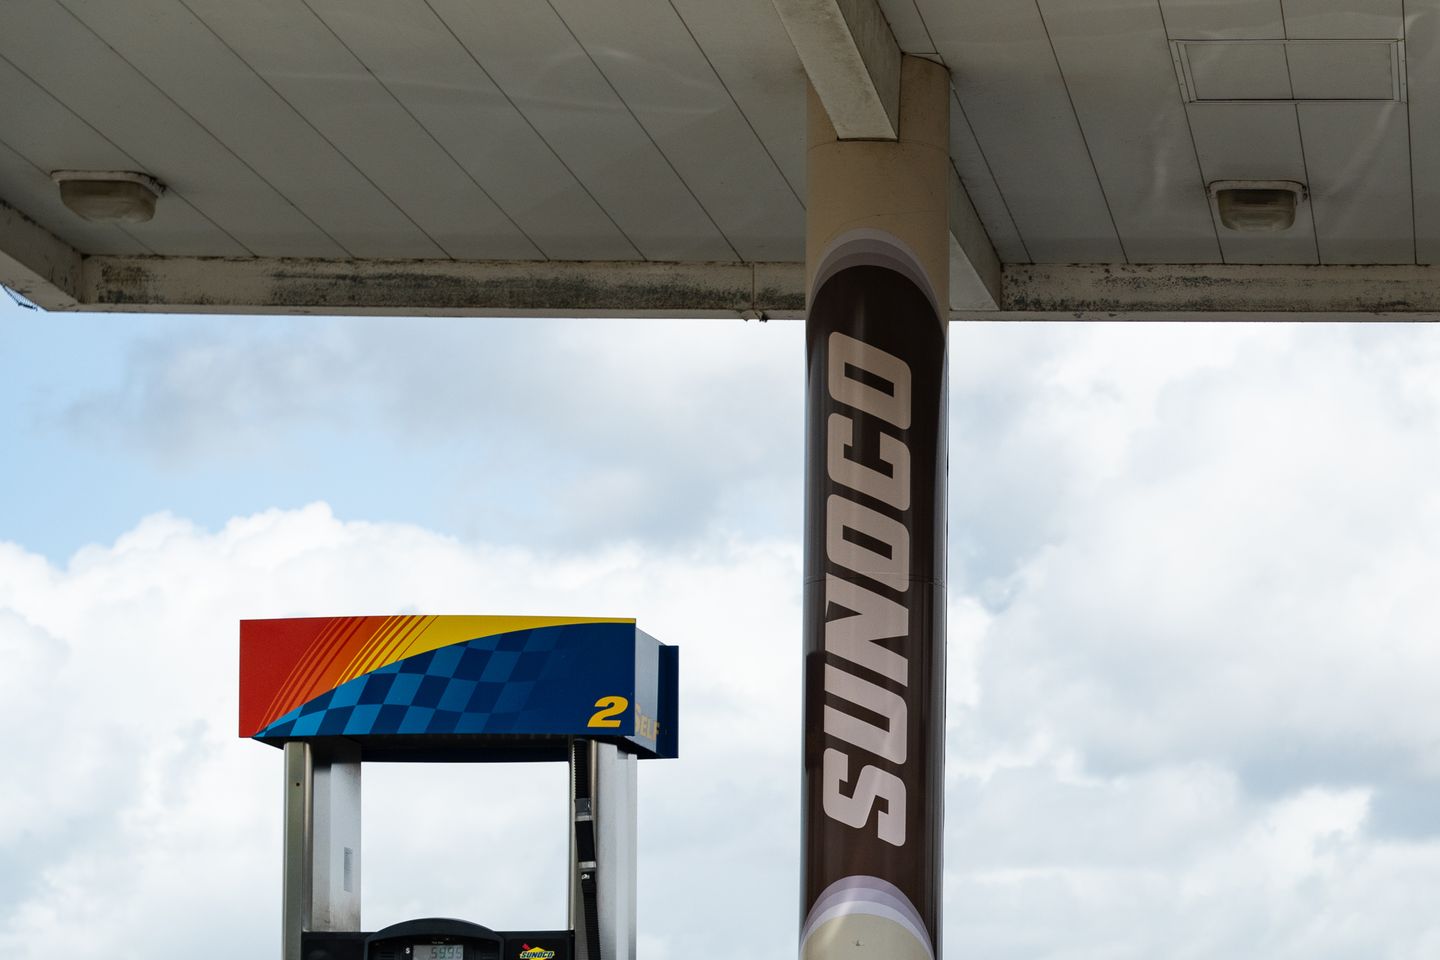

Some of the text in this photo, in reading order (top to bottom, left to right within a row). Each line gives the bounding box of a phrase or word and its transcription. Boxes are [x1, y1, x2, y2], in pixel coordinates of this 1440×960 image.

[823, 331, 911, 846] SUNOCO
[587, 696, 629, 728] 2
[520, 951, 554, 959] SUNOCO
